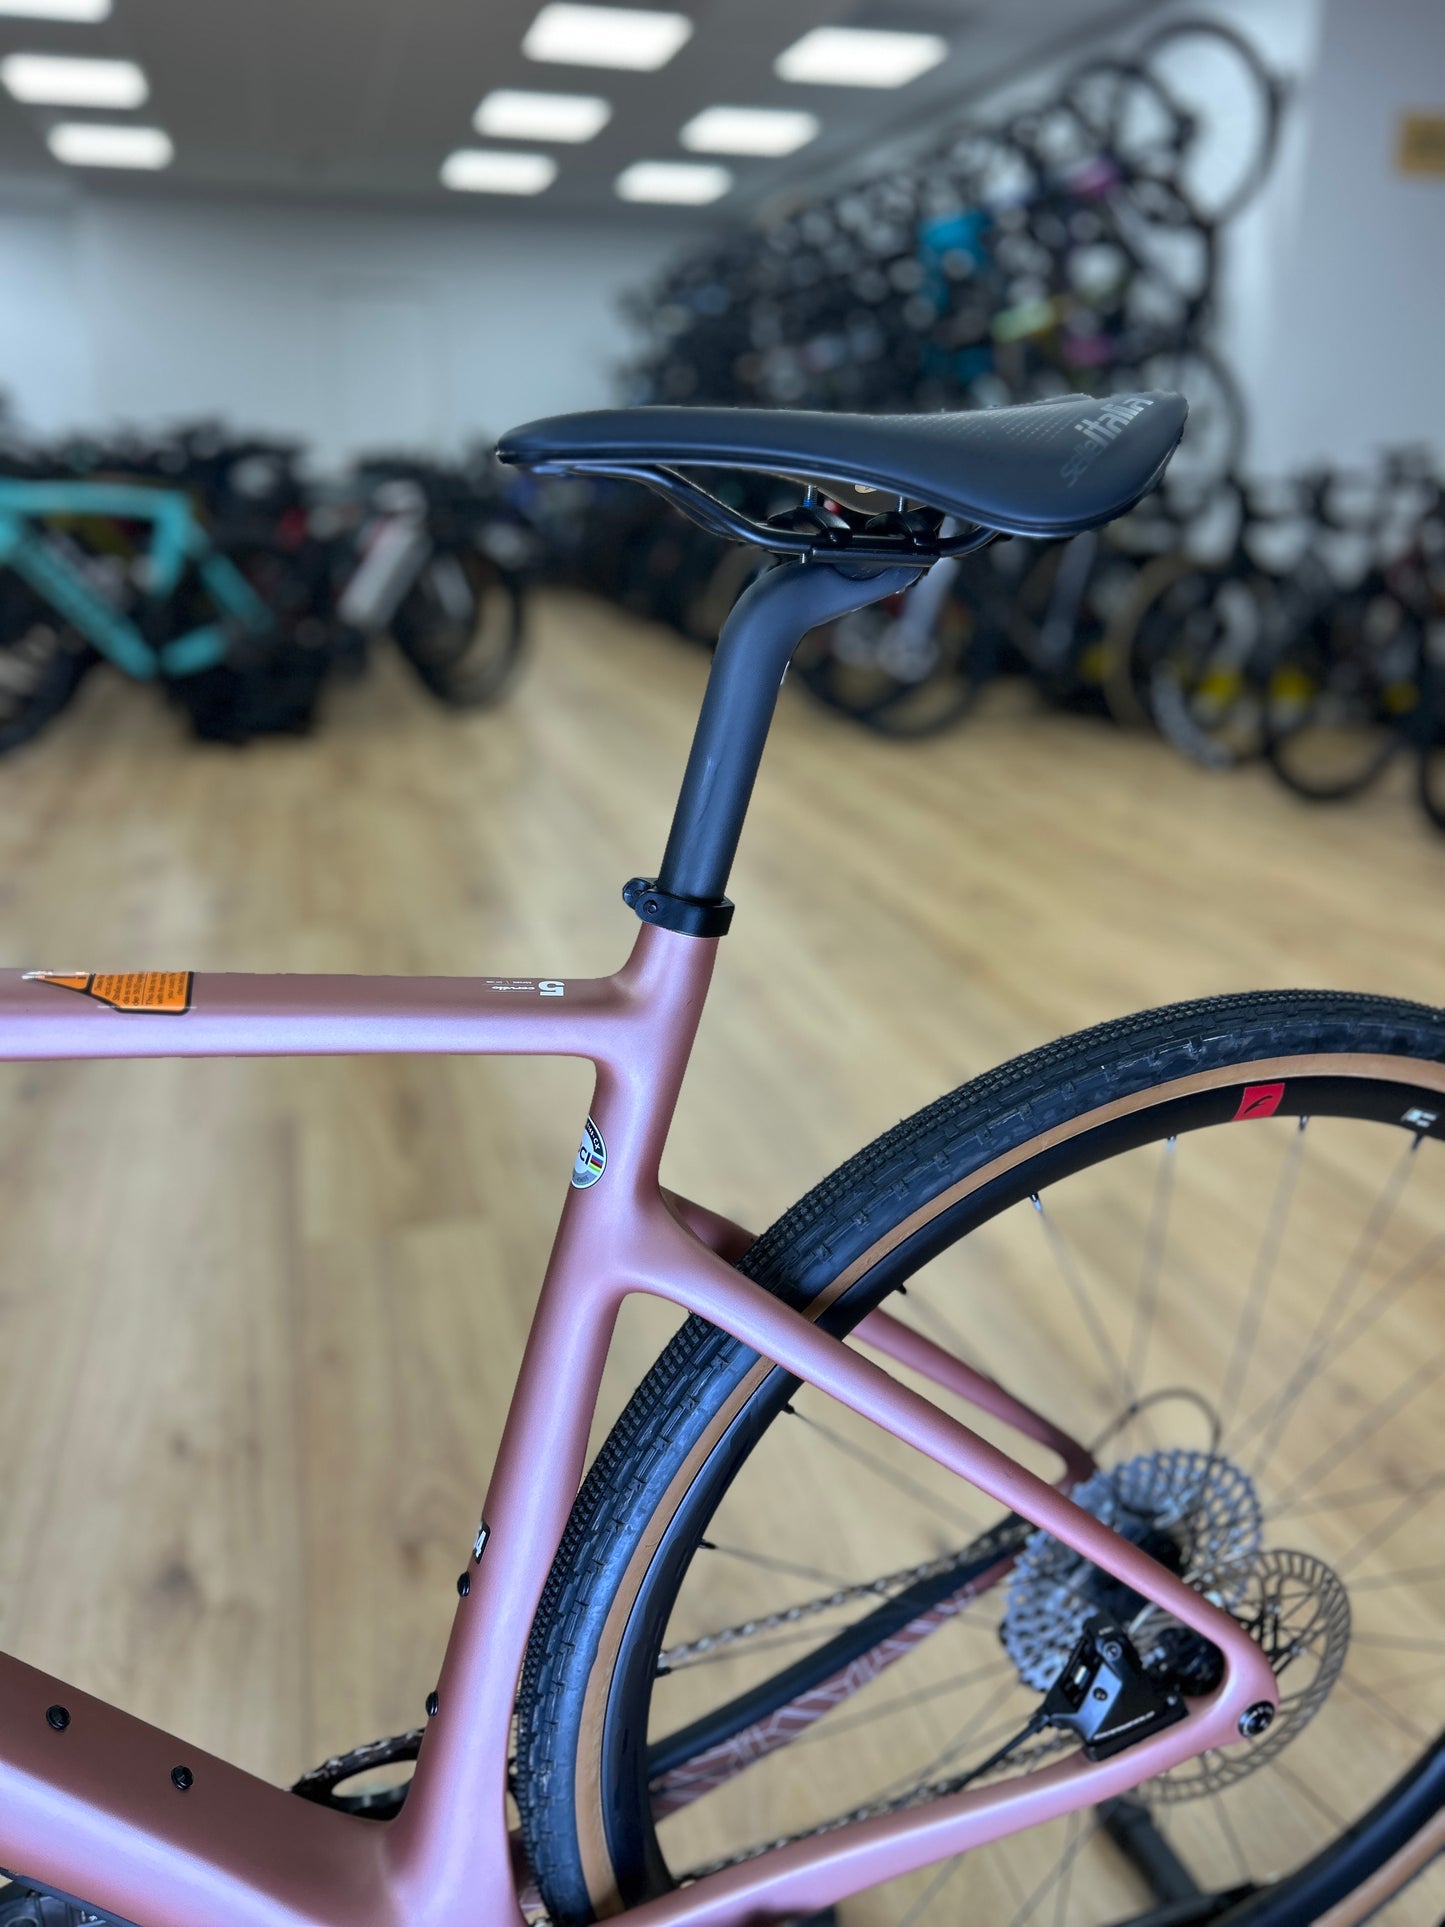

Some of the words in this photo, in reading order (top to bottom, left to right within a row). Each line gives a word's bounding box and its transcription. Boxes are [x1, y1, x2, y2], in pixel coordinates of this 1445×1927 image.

[1074, 398, 1154, 448] italia
[538, 980, 565, 997] 5
[578, 1141, 591, 1165] CI
